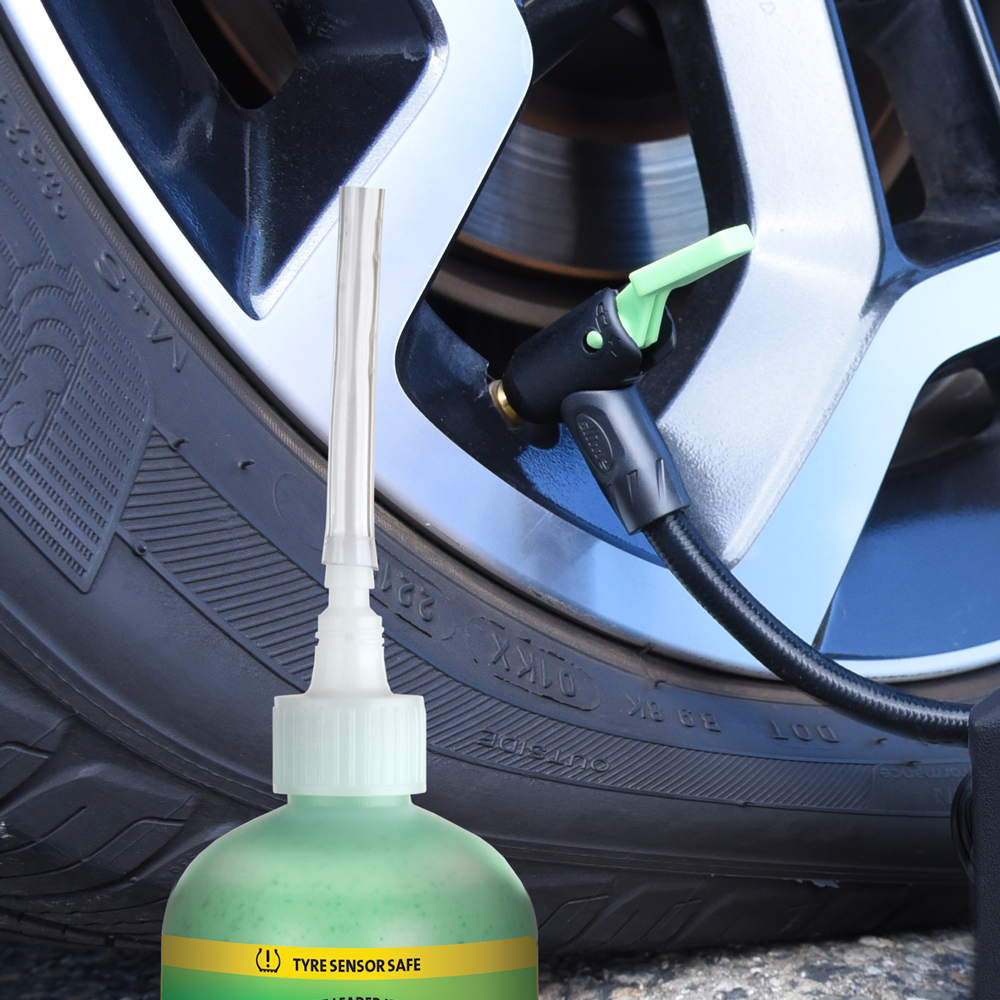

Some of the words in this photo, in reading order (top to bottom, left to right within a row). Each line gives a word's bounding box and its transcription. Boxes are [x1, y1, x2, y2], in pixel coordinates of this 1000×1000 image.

[577, 419, 608, 470] slime
[378, 561, 435, 622] 221
[477, 728, 610, 773] OUTSIDE
[771, 719, 840, 744] DOT
[293, 958, 327, 973] TYRE
[329, 958, 385, 973] SENSOR
[388, 957, 421, 972] SAFE
